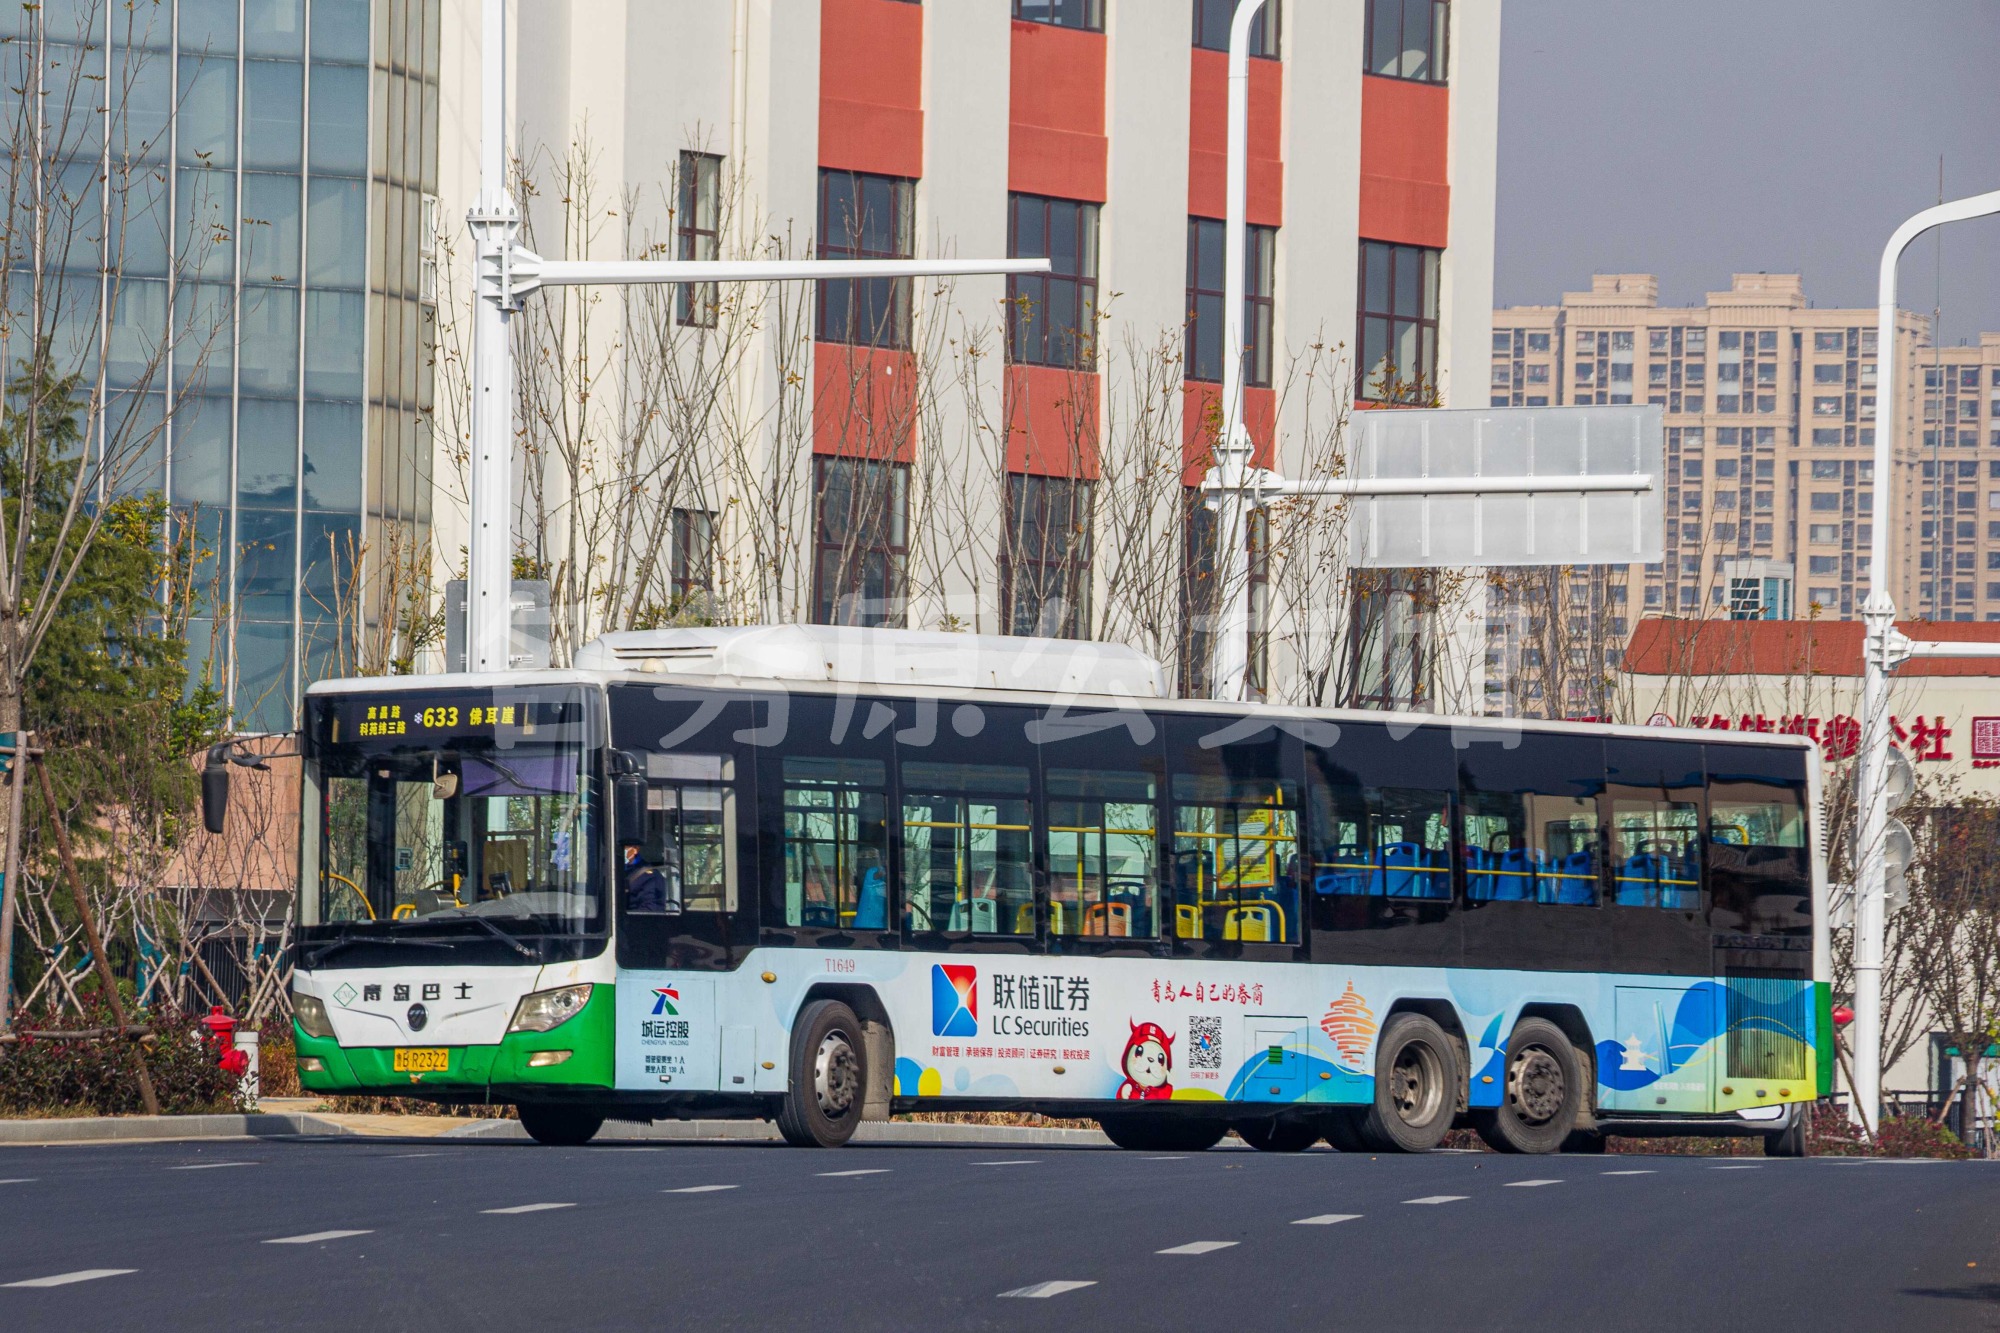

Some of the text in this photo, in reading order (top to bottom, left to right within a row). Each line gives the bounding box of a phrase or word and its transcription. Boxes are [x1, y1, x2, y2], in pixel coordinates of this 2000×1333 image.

[423, 707, 458, 727] 633
[469, 707, 515, 725] 佛耳崖
[359, 721, 406, 736] 科苑纬三路
[825, 959, 855, 973] T1649
[363, 982, 473, 1001] 青岛巴士
[993, 974, 1090, 1011] 联储证券
[641, 1021, 689, 1038] 城运控股
[993, 1015, 1089, 1037] LC Securities
[932, 1046, 1090, 1060] 财富管理 承销保荐 投资顾问 证券研究 股权投资
